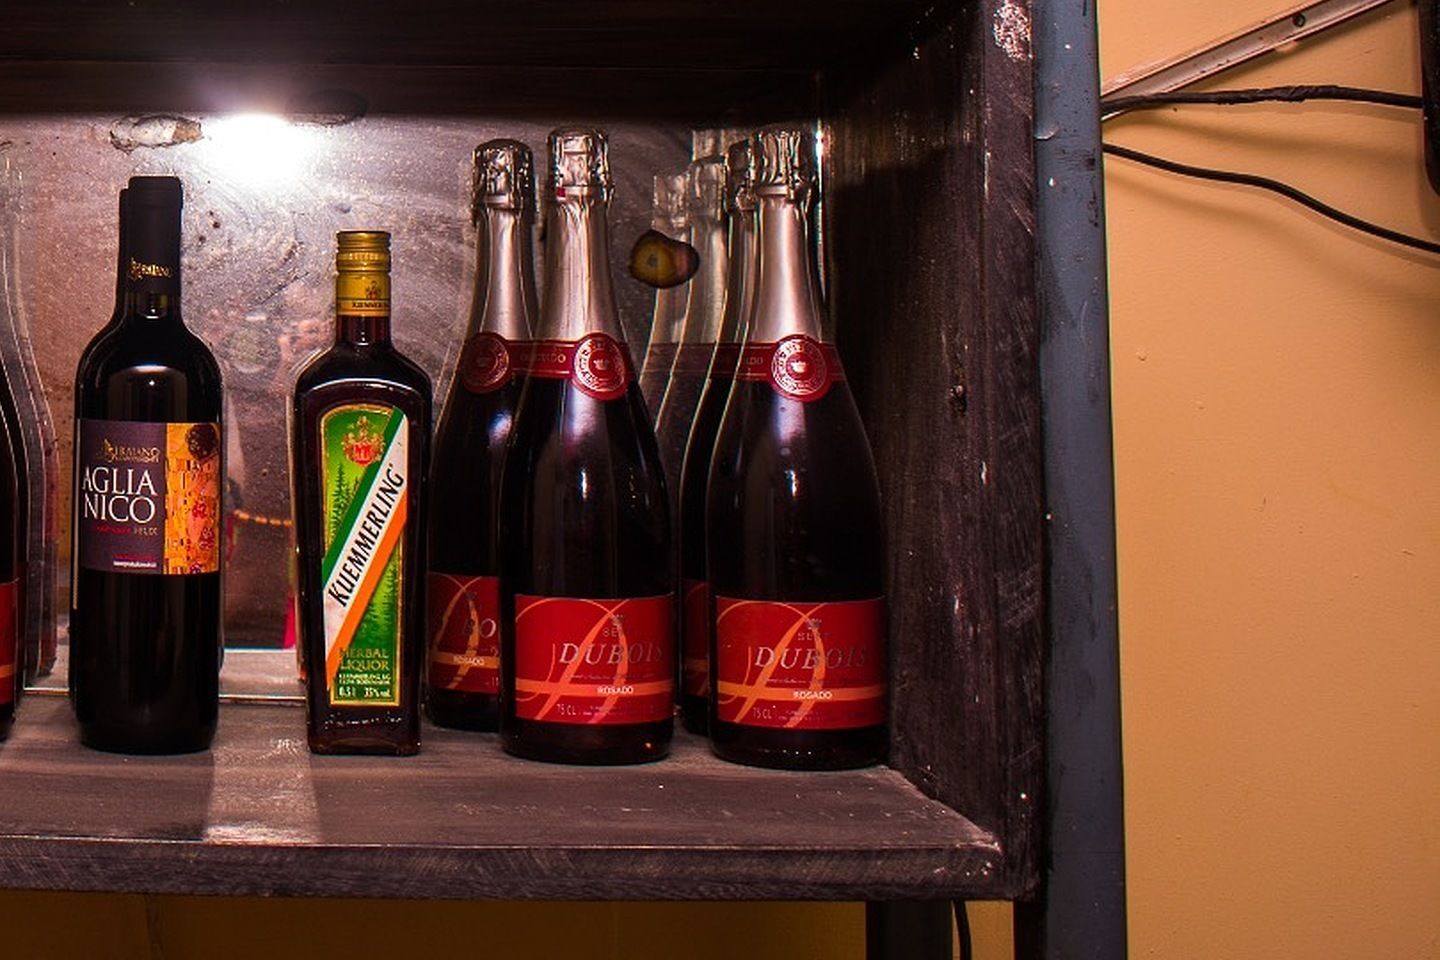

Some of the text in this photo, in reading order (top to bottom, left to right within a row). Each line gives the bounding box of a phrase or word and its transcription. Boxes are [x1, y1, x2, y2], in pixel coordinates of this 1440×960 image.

[82, 466, 158, 496] AGLIA
[84, 492, 156, 524] NICO
[328, 467, 404, 608] KUEMMERLING
[339, 648, 389, 659] HERBAL
[340, 659, 390, 672] LIQUOR
[597, 685, 634, 695] ROSADO
[793, 690, 832, 700] ROSADO
